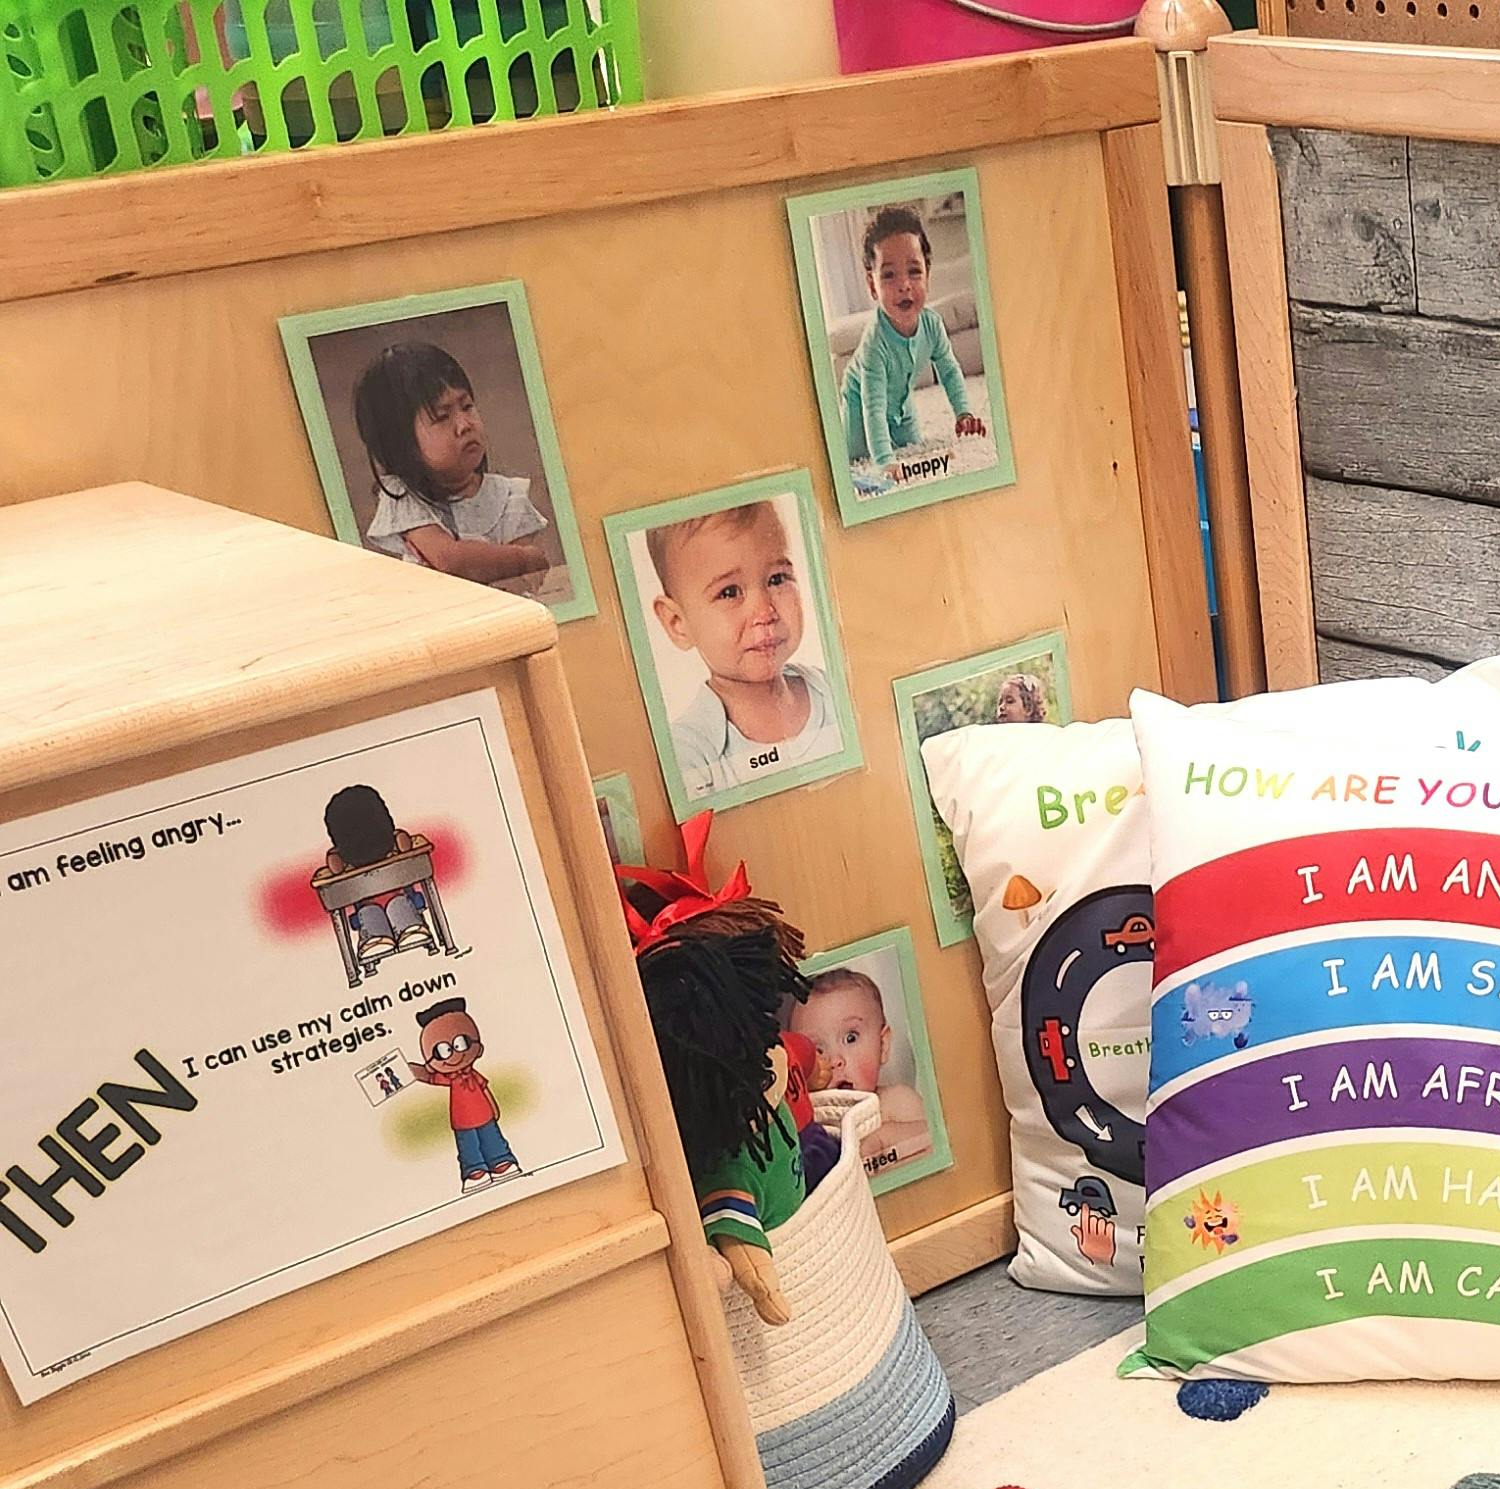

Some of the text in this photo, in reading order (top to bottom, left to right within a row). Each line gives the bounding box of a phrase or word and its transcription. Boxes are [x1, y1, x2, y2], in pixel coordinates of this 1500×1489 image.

[901, 454, 950, 480] happy
[749, 746, 779, 769] sad
[1184, 762, 1294, 799] HOW
[1311, 774, 1400, 804] ARE
[1037, 785, 1145, 829] Bre
[7, 812, 242, 891] am feeling angry...
[1297, 865, 1323, 904] I
[1347, 854, 1418, 895] AM
[1322, 958, 1349, 997] I
[1371, 951, 1442, 992] AM
[182, 972, 457, 1079] I can use my calm down
[271, 1021, 393, 1075] strategies.
[1088, 1037, 1151, 1057] Breath
[1282, 1074, 1309, 1112] I
[1331, 1061, 1398, 1102] AM
[0, 1048, 198, 1253] THEN
[864, 1148, 898, 1172] rised
[1301, 1174, 1328, 1210] I
[1351, 1165, 1418, 1202] AM
[1316, 1268, 1344, 1300] I
[1367, 1260, 1434, 1295] AM
